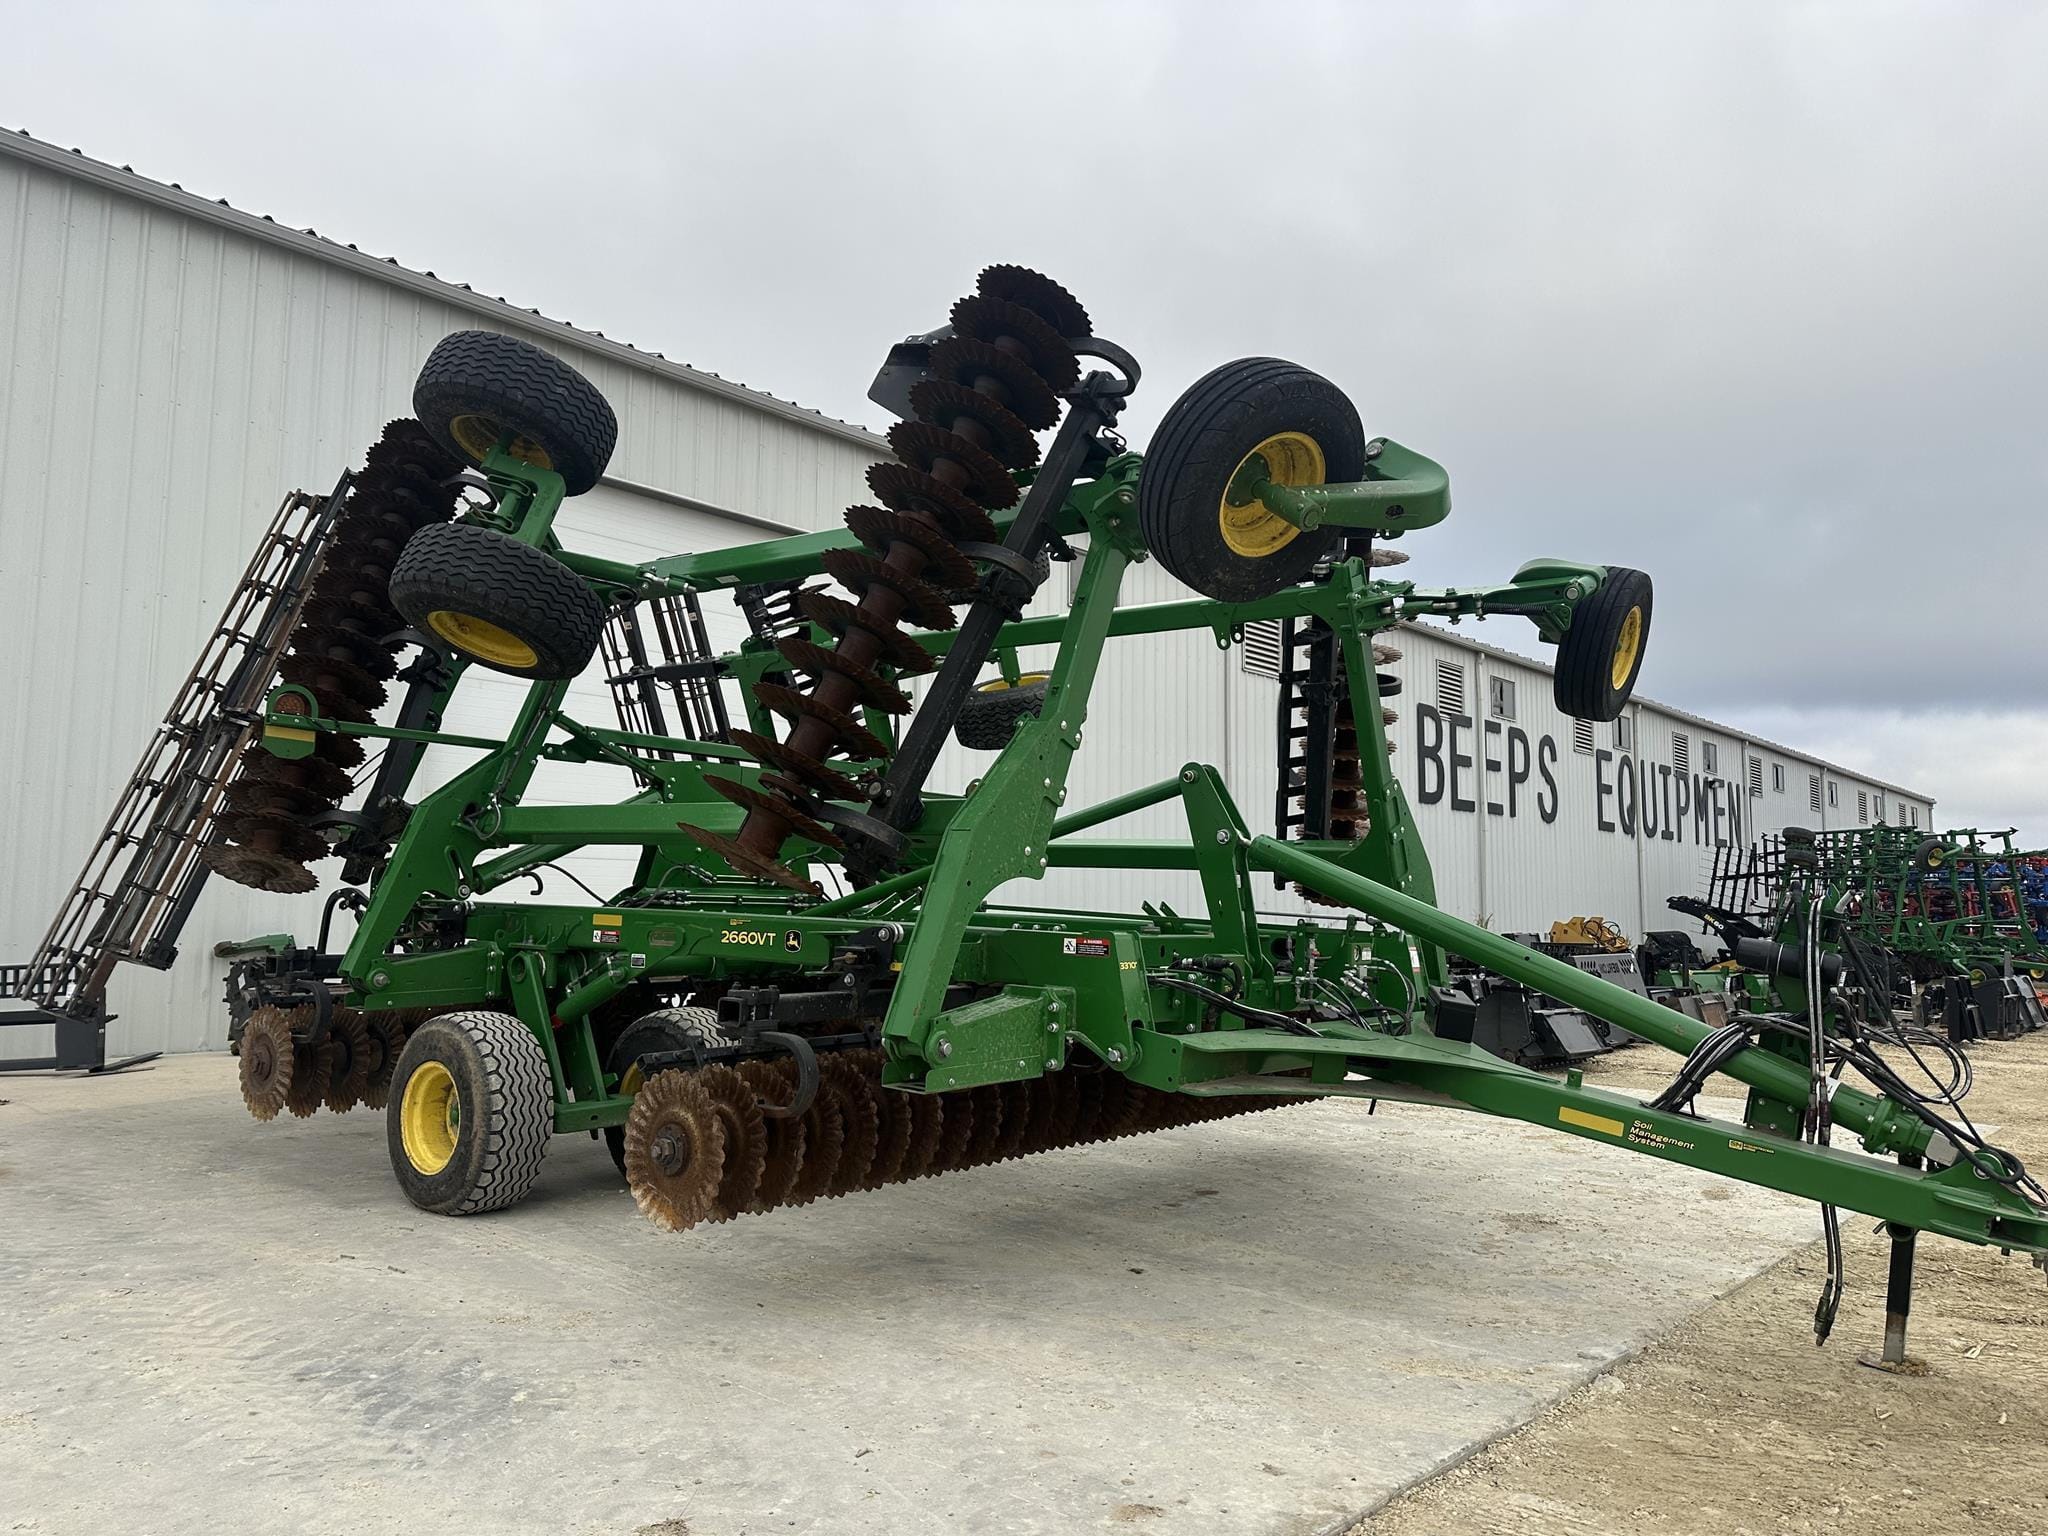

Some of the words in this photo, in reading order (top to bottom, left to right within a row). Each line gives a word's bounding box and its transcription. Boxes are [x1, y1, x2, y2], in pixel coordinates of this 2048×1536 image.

[1416, 702, 1559, 824] BEEPS
[721, 930, 777, 946] 2660VT
[1633, 1119, 1653, 1130] Soil
[1628, 1133, 1666, 1150] System
[1629, 1126, 1695, 1150] Management
